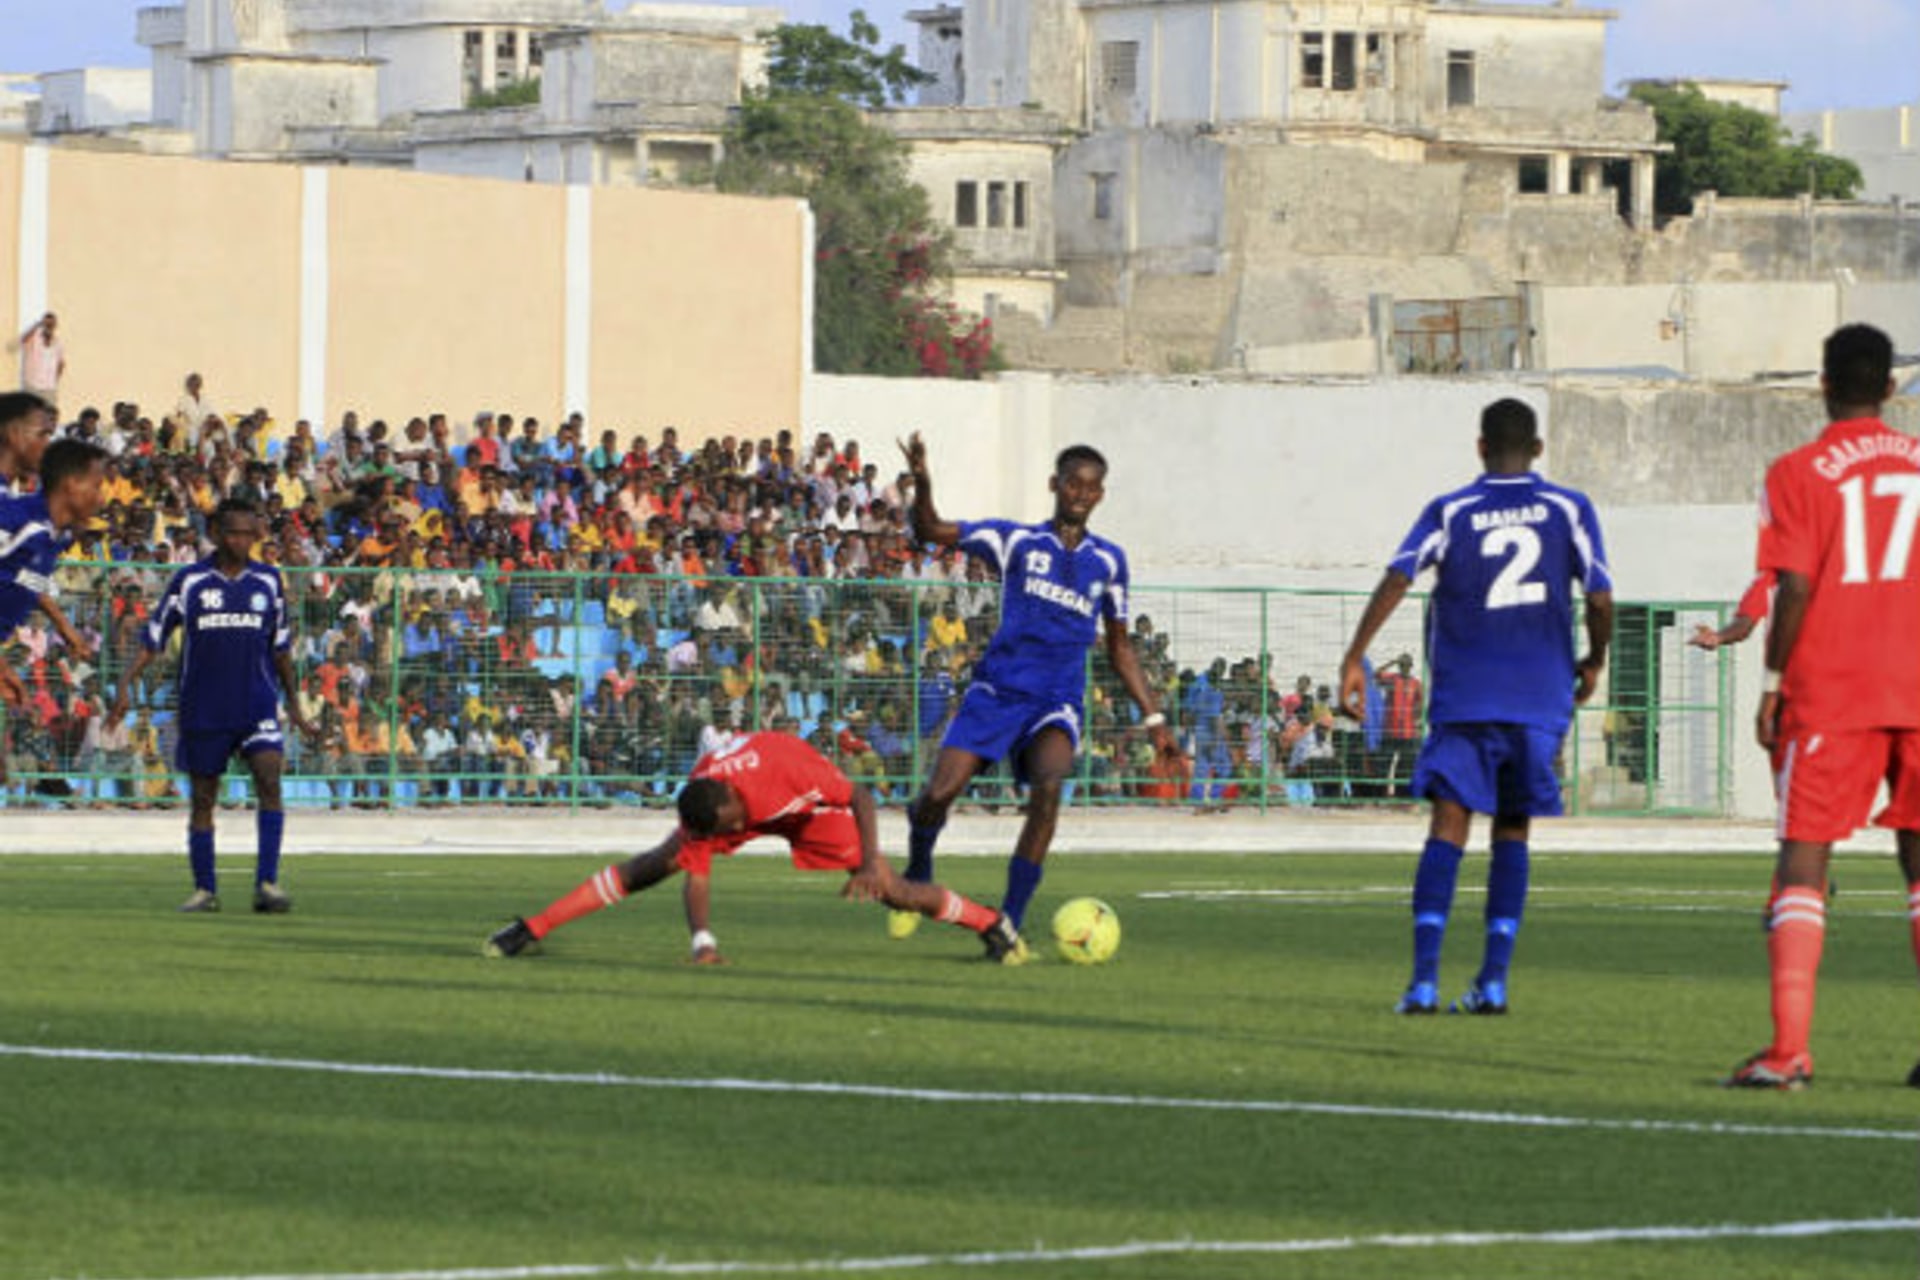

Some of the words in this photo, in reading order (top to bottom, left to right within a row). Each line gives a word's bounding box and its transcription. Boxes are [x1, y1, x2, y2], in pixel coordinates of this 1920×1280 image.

[1838, 473, 1920, 583] 17
[1025, 550, 1051, 574] 13
[1481, 525, 1547, 609] 2
[199, 588, 224, 610] 16
